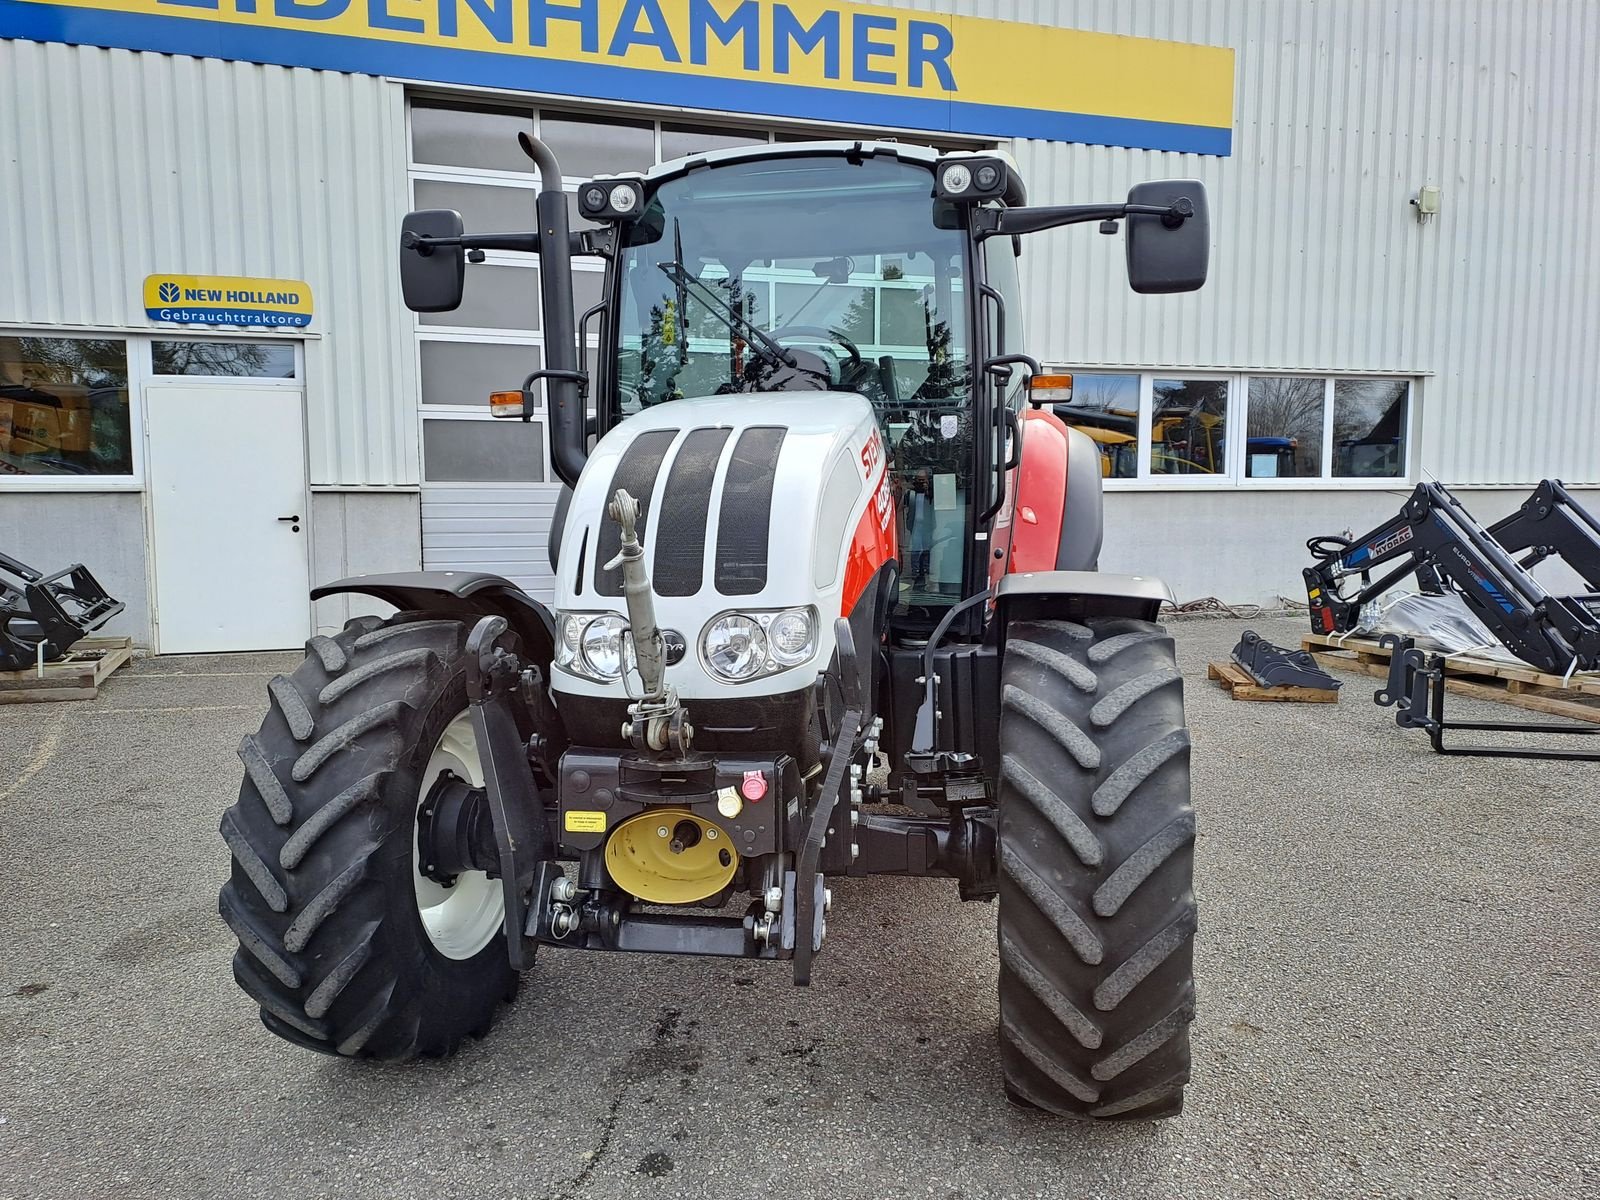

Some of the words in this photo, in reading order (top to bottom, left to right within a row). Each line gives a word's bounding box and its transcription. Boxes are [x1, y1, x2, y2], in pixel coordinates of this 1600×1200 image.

[185, 288, 222, 302] NEW
[226, 290, 300, 305] HOLLAND
[160, 308, 302, 325] Gebrauchttraktore
[1375, 532, 1411, 556] HYDRAC
[1452, 546, 1473, 567] EURO
